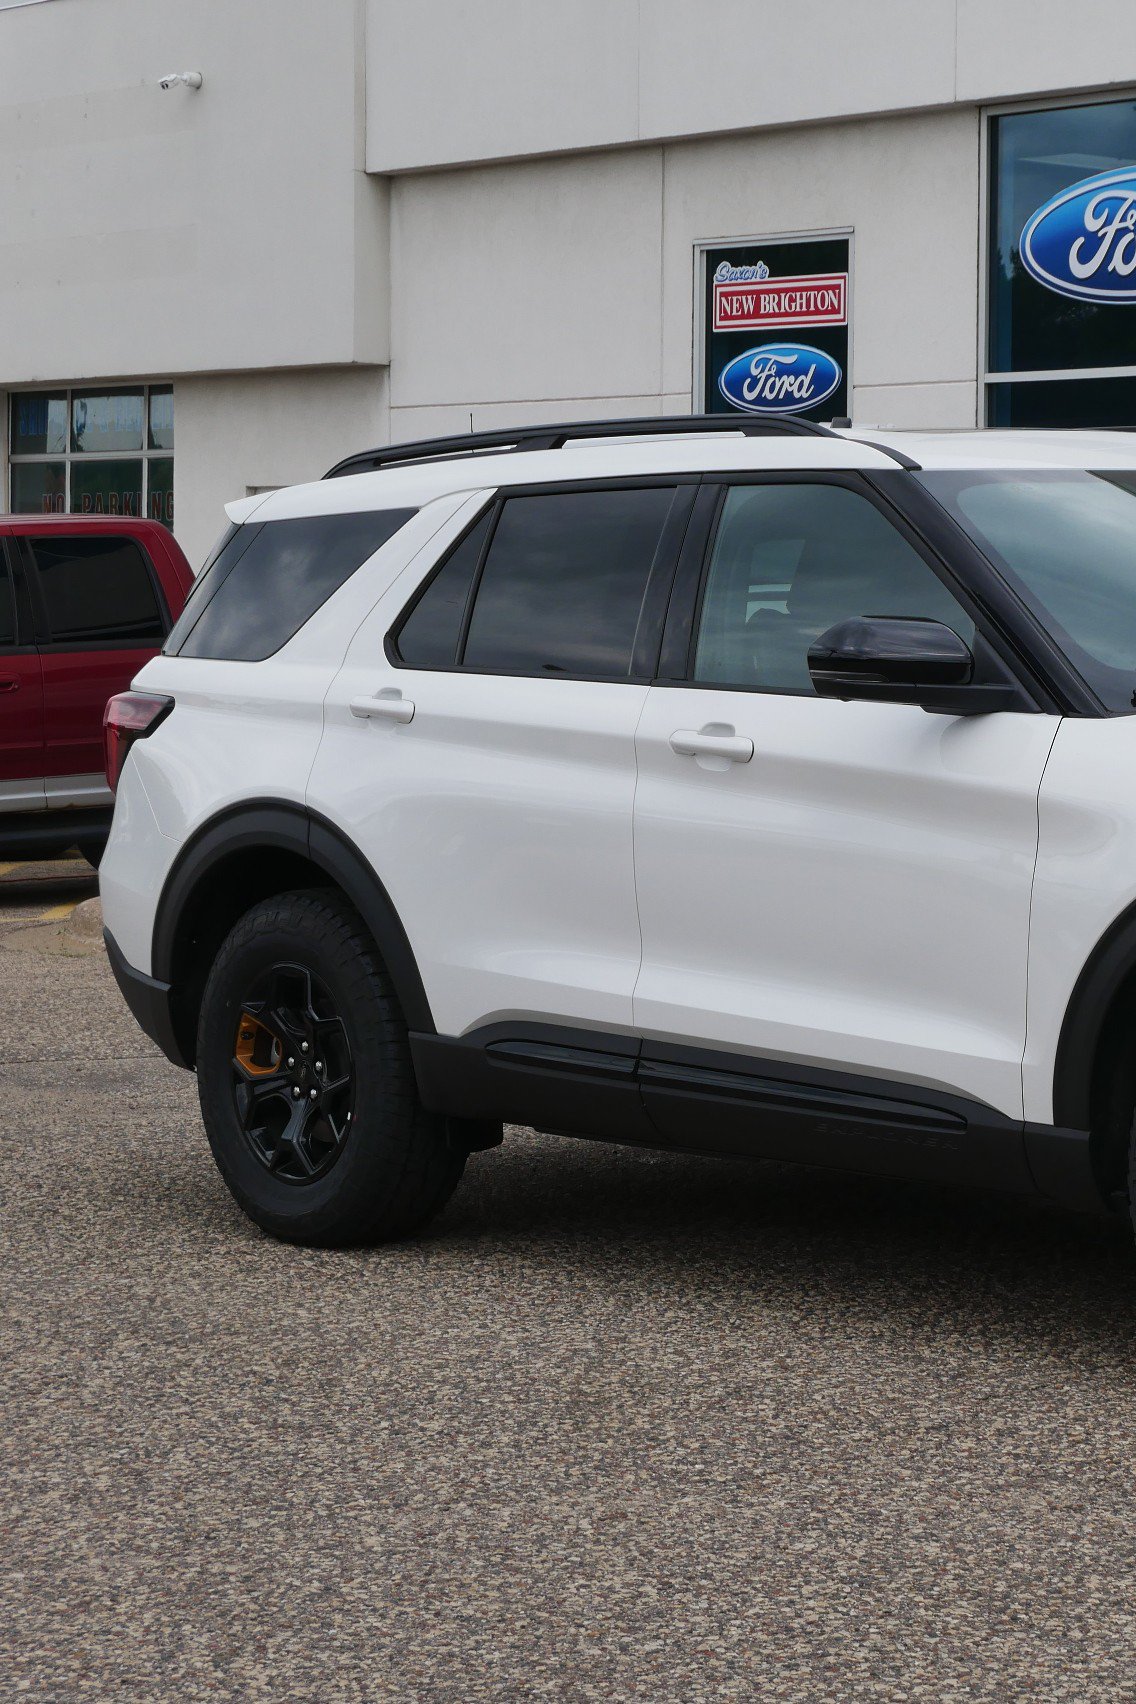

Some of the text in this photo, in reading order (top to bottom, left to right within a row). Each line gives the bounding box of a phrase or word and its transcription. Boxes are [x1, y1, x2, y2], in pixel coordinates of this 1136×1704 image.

[714, 261, 768, 283] Saxon's
[720, 289, 840, 317] NEW BRIGHTON
[743, 353, 816, 401] Ford
